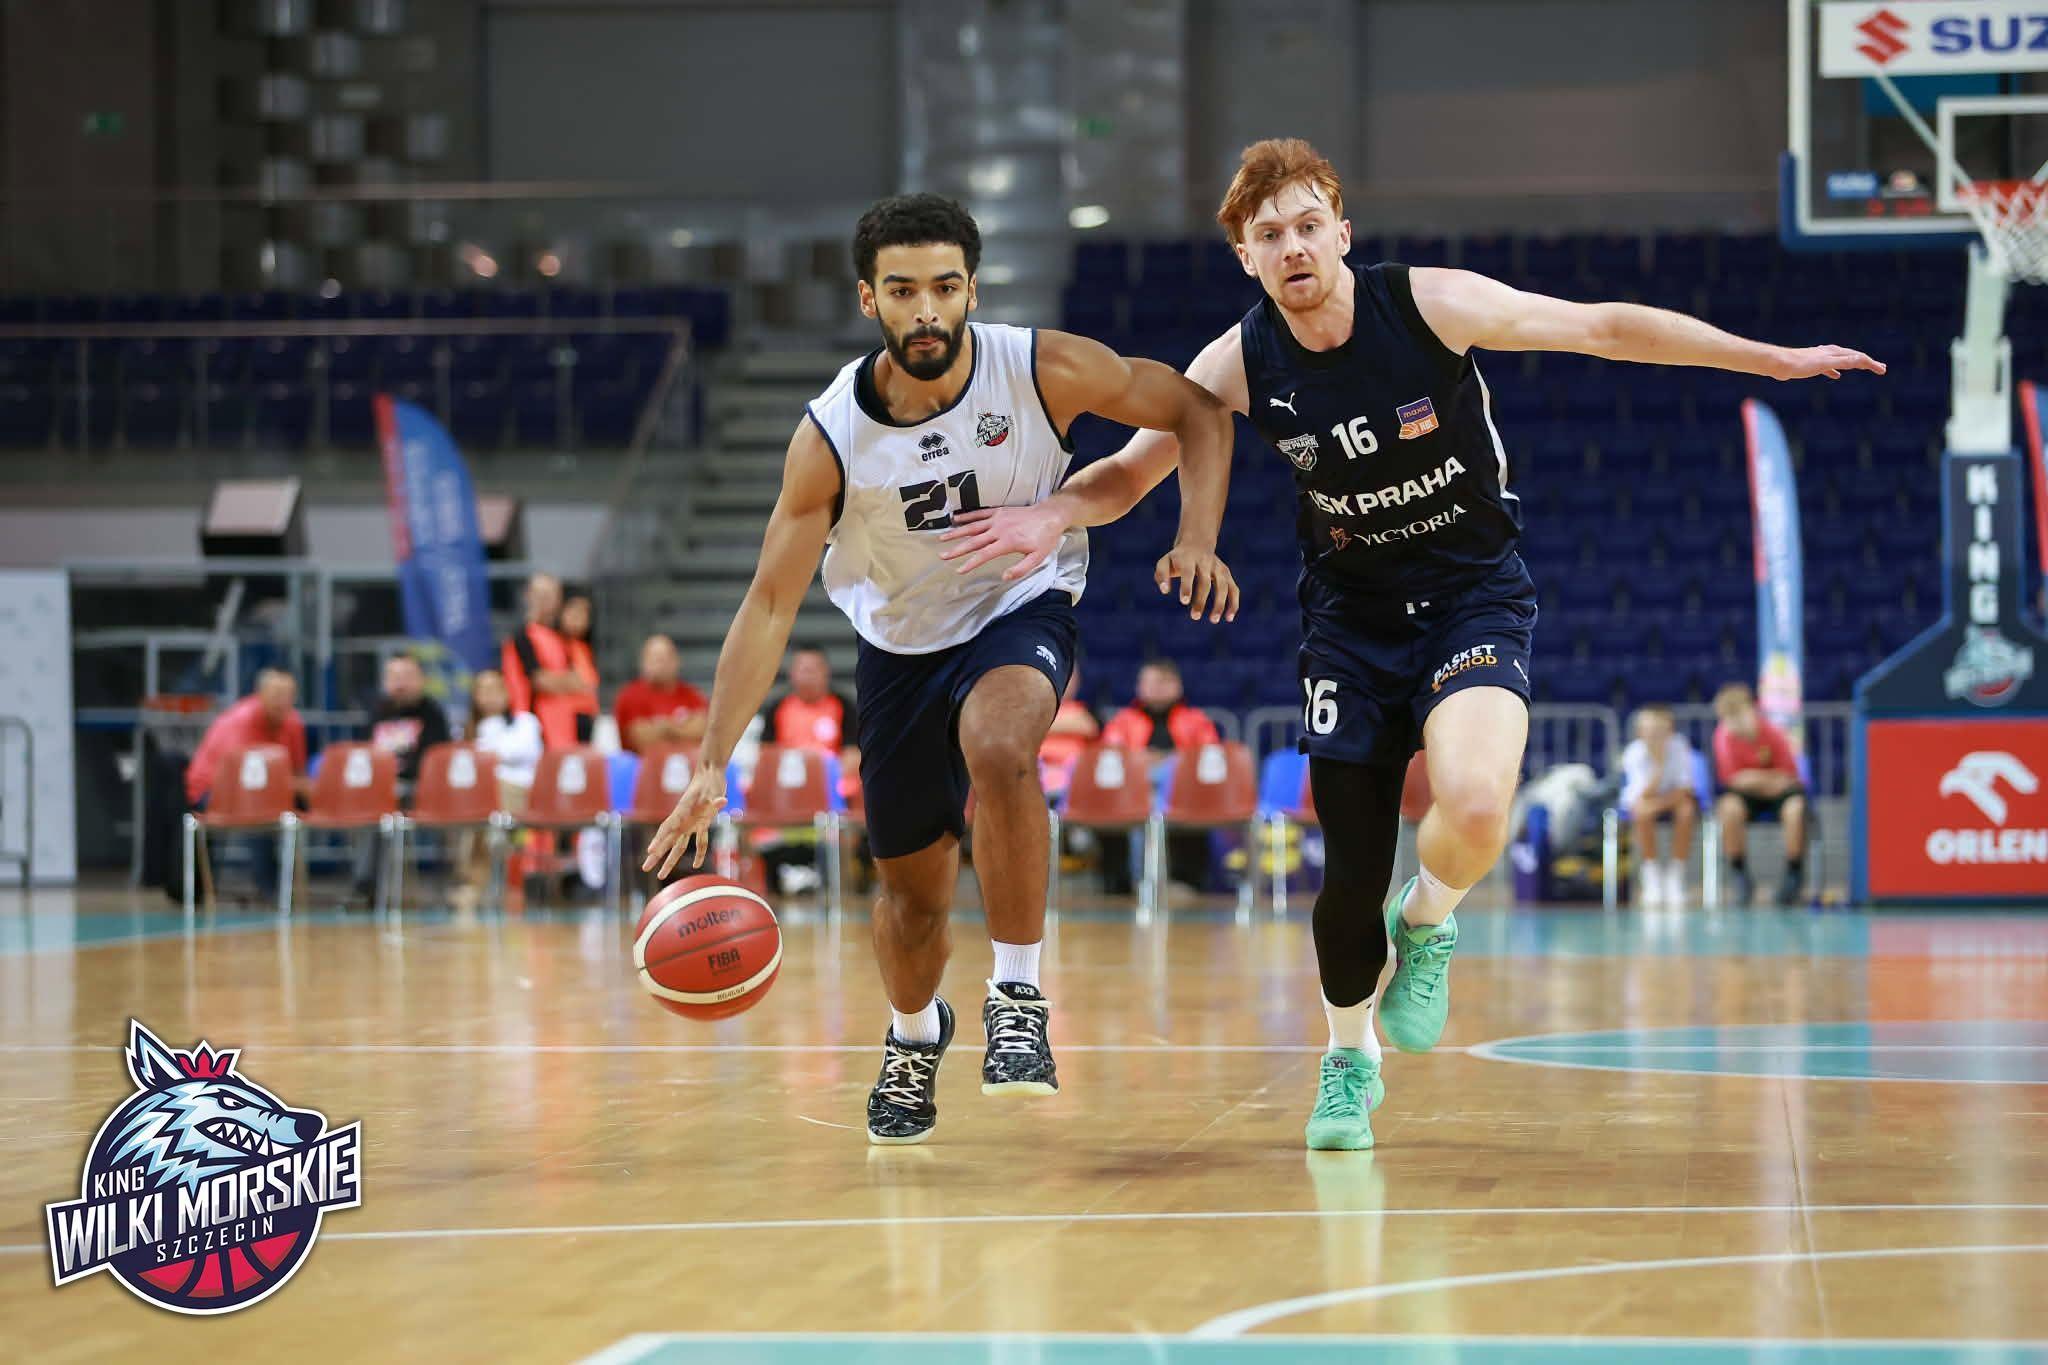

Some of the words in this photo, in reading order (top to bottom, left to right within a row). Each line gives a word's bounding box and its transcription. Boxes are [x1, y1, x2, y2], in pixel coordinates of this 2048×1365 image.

[921, 447, 950, 461] errea
[1332, 416, 1378, 459] 16
[899, 469, 980, 531] 21
[1356, 456, 1466, 514] PRAHA
[1354, 503, 1467, 546] VICTORIA
[1967, 464, 1999, 624] KING
[1926, 828, 2048, 864] ORLEN
[678, 909, 740, 937] molten
[707, 948, 740, 969] FIBA
